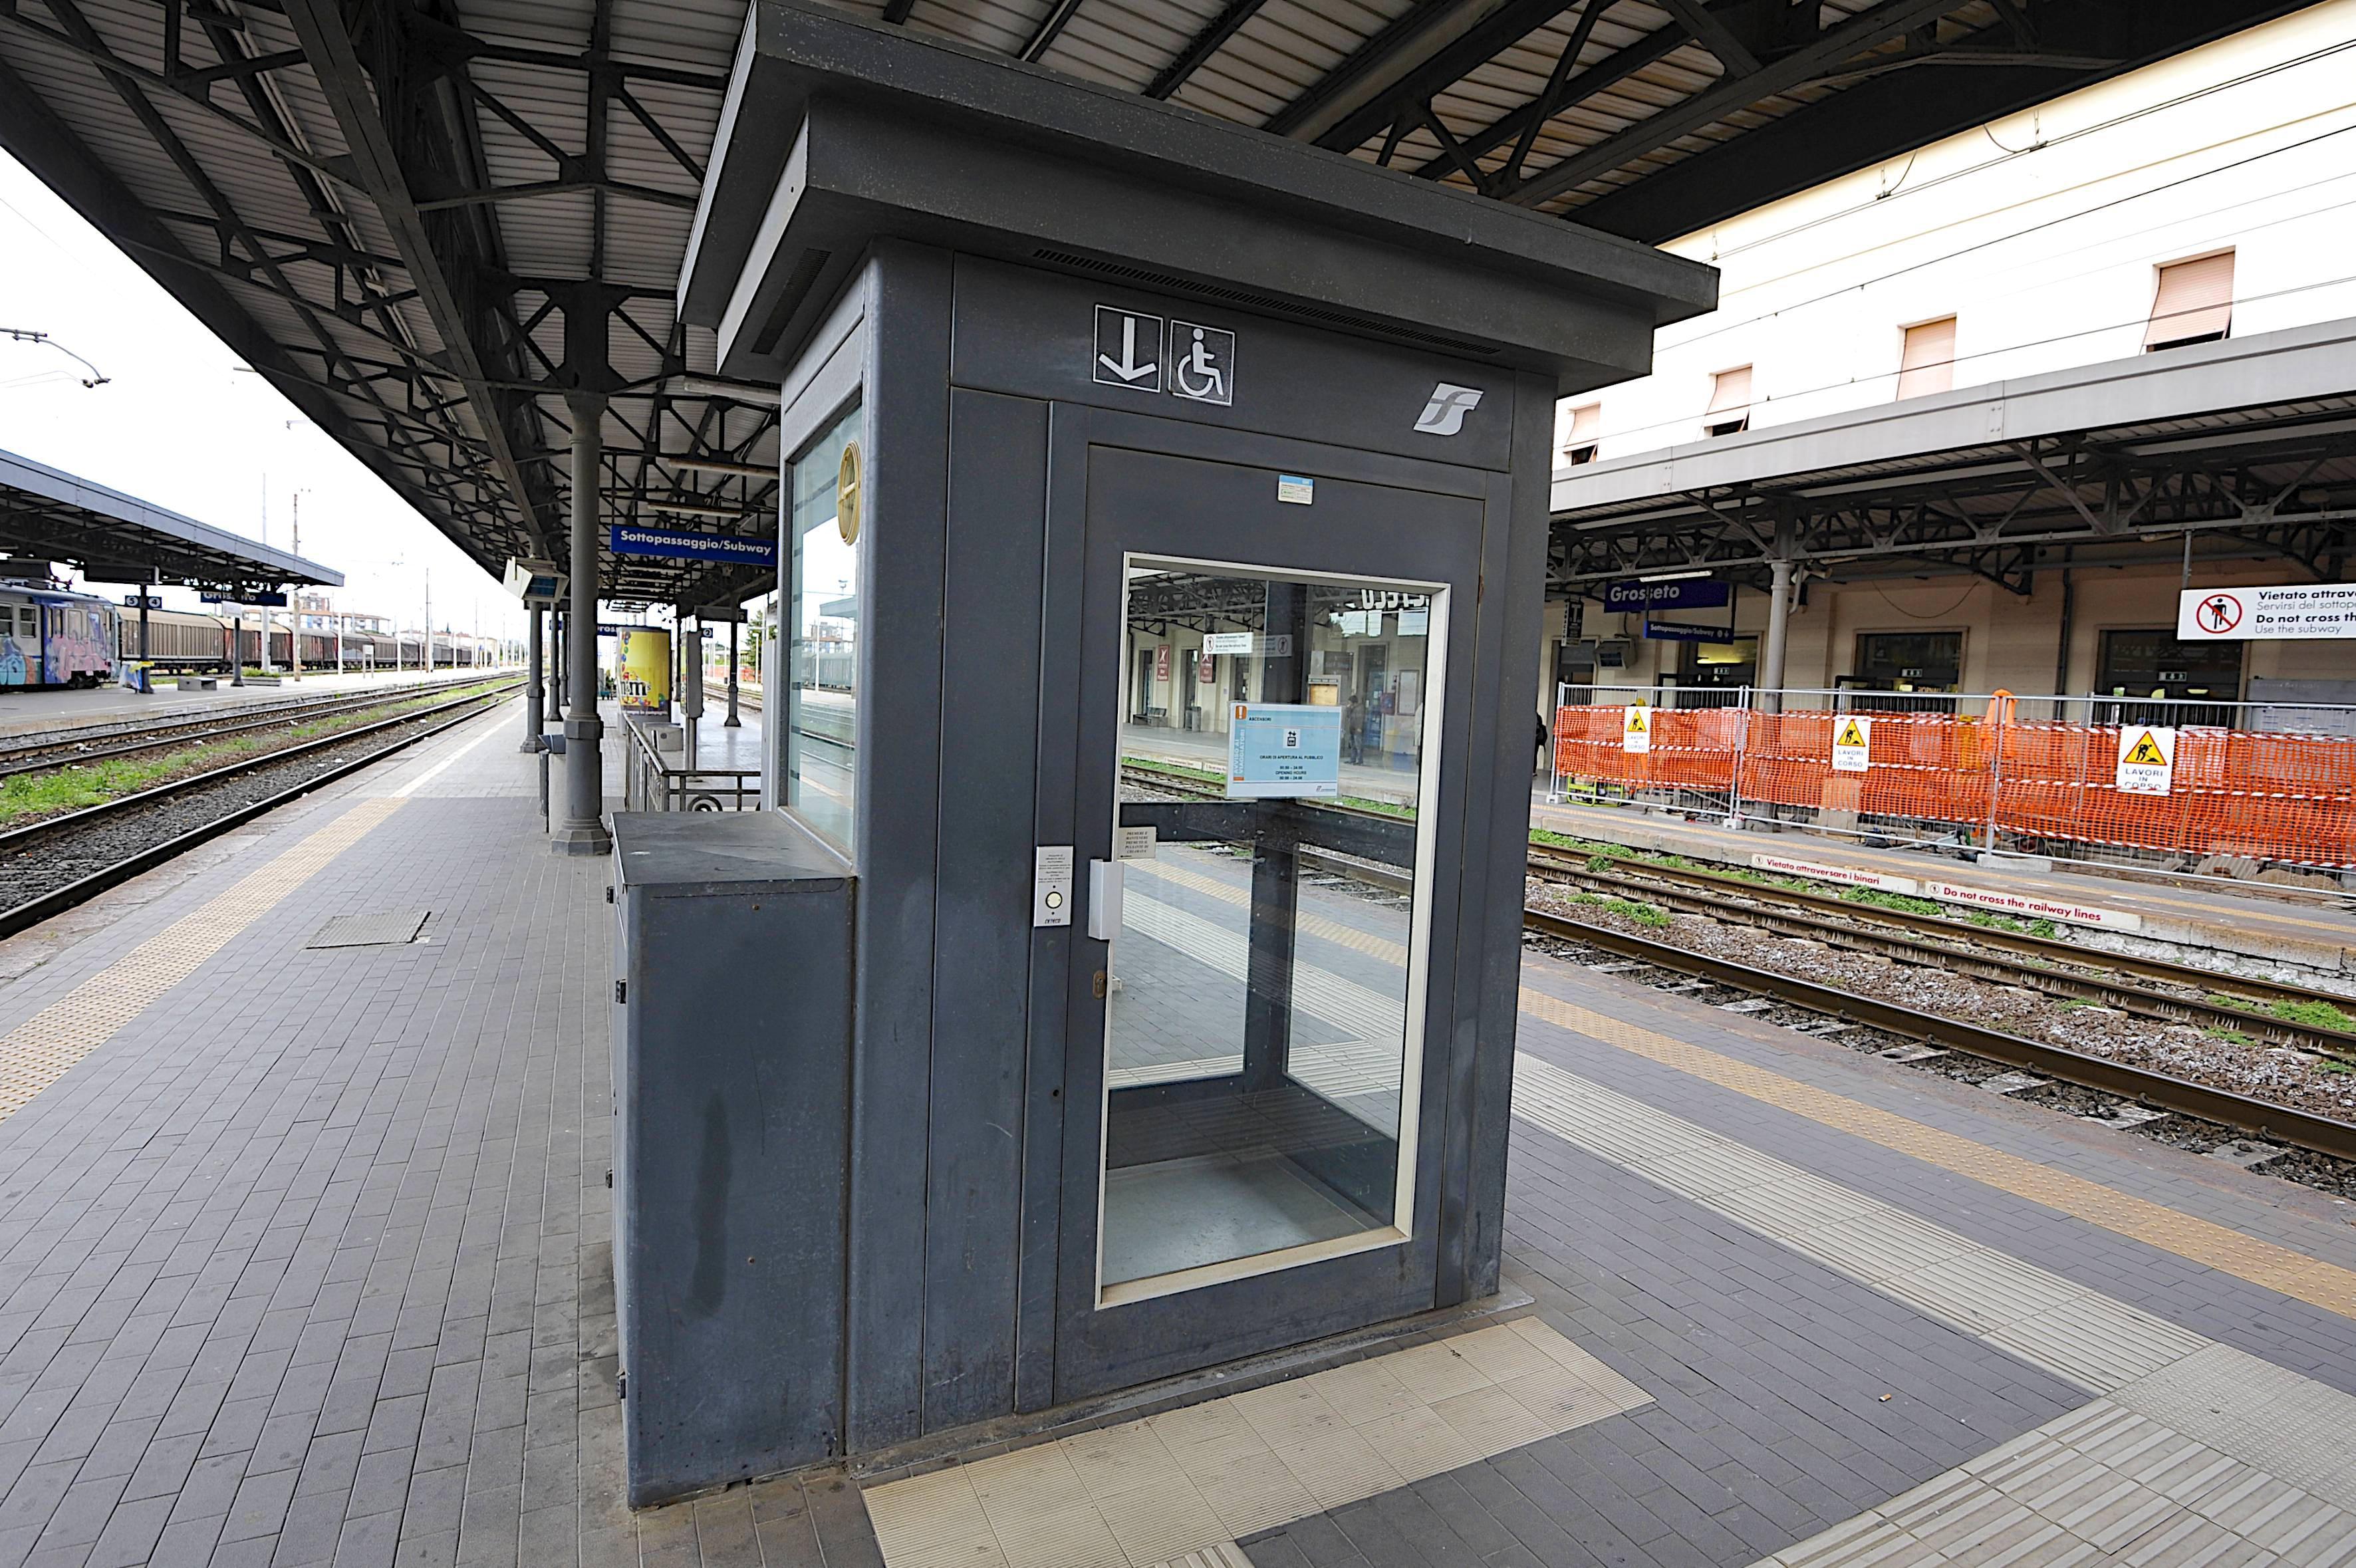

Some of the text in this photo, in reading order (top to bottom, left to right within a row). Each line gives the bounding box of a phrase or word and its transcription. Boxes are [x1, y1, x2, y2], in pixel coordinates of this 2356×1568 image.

[620, 530, 772, 556] Sottopassaggio/Subway
[1610, 585, 1680, 602] Grosseto
[2259, 591, 2307, 600] Vietato
[2257, 601, 2295, 610] Servirsi
[2298, 600, 2315, 609] del
[2256, 614, 2274, 623] Do
[2255, 624, 2342, 634] Use the subway
[2125, 768, 2162, 777] LAVORI
[1766, 858, 1794, 870] Vietato
[1796, 864, 1847, 880] attraversare
[1854, 873, 1880, 885] binari
[1943, 887, 2101, 921] Do not cross the railway lines
